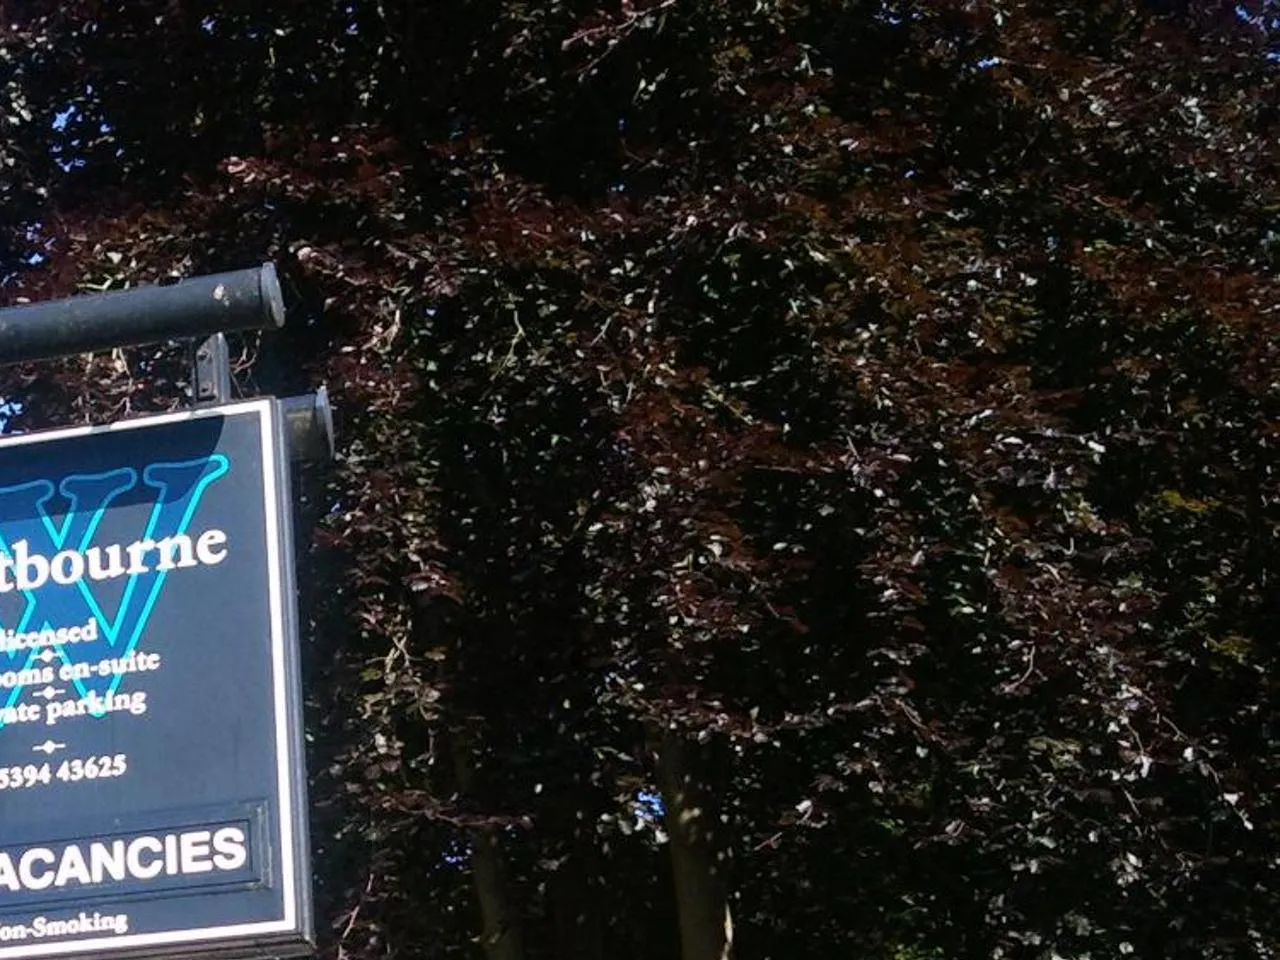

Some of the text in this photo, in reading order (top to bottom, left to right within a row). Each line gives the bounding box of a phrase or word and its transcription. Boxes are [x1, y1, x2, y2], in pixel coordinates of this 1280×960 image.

[59, 648, 161, 681] en-suite
[46, 690, 147, 724] parking
[56, 754, 127, 782] 43625
